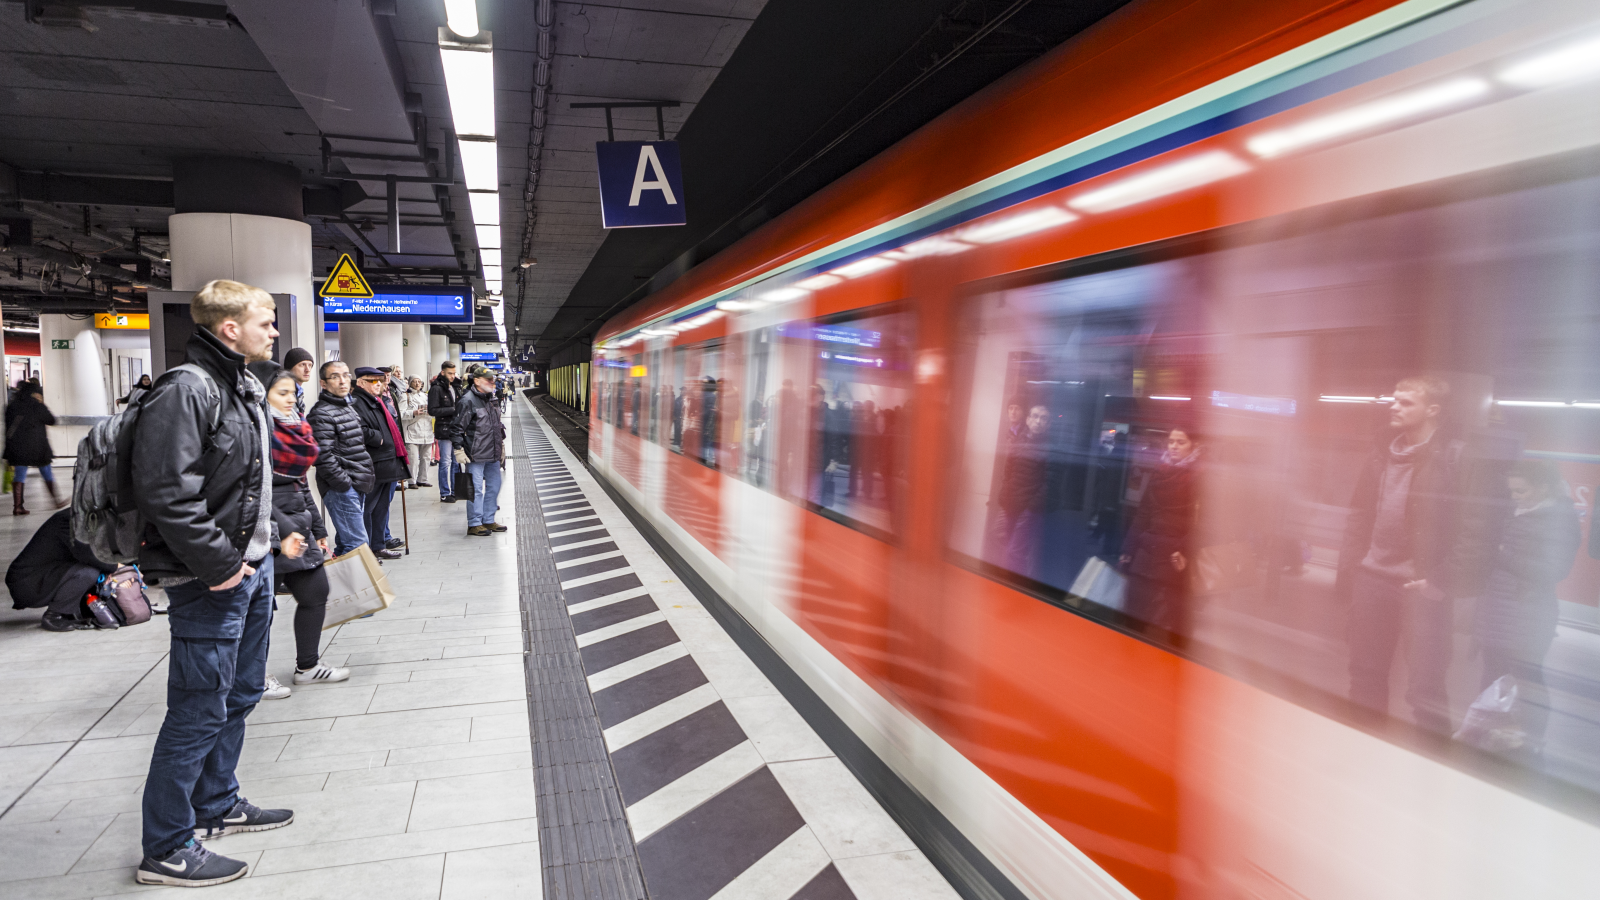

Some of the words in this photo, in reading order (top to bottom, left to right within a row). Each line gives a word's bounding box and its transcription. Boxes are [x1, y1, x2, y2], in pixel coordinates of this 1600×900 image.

[628, 145, 677, 206] A
[352, 304, 410, 313] Niedernhausen
[454, 296, 464, 310] 3
[527, 344, 536, 354] A
[325, 587, 368, 611] SPRIT
